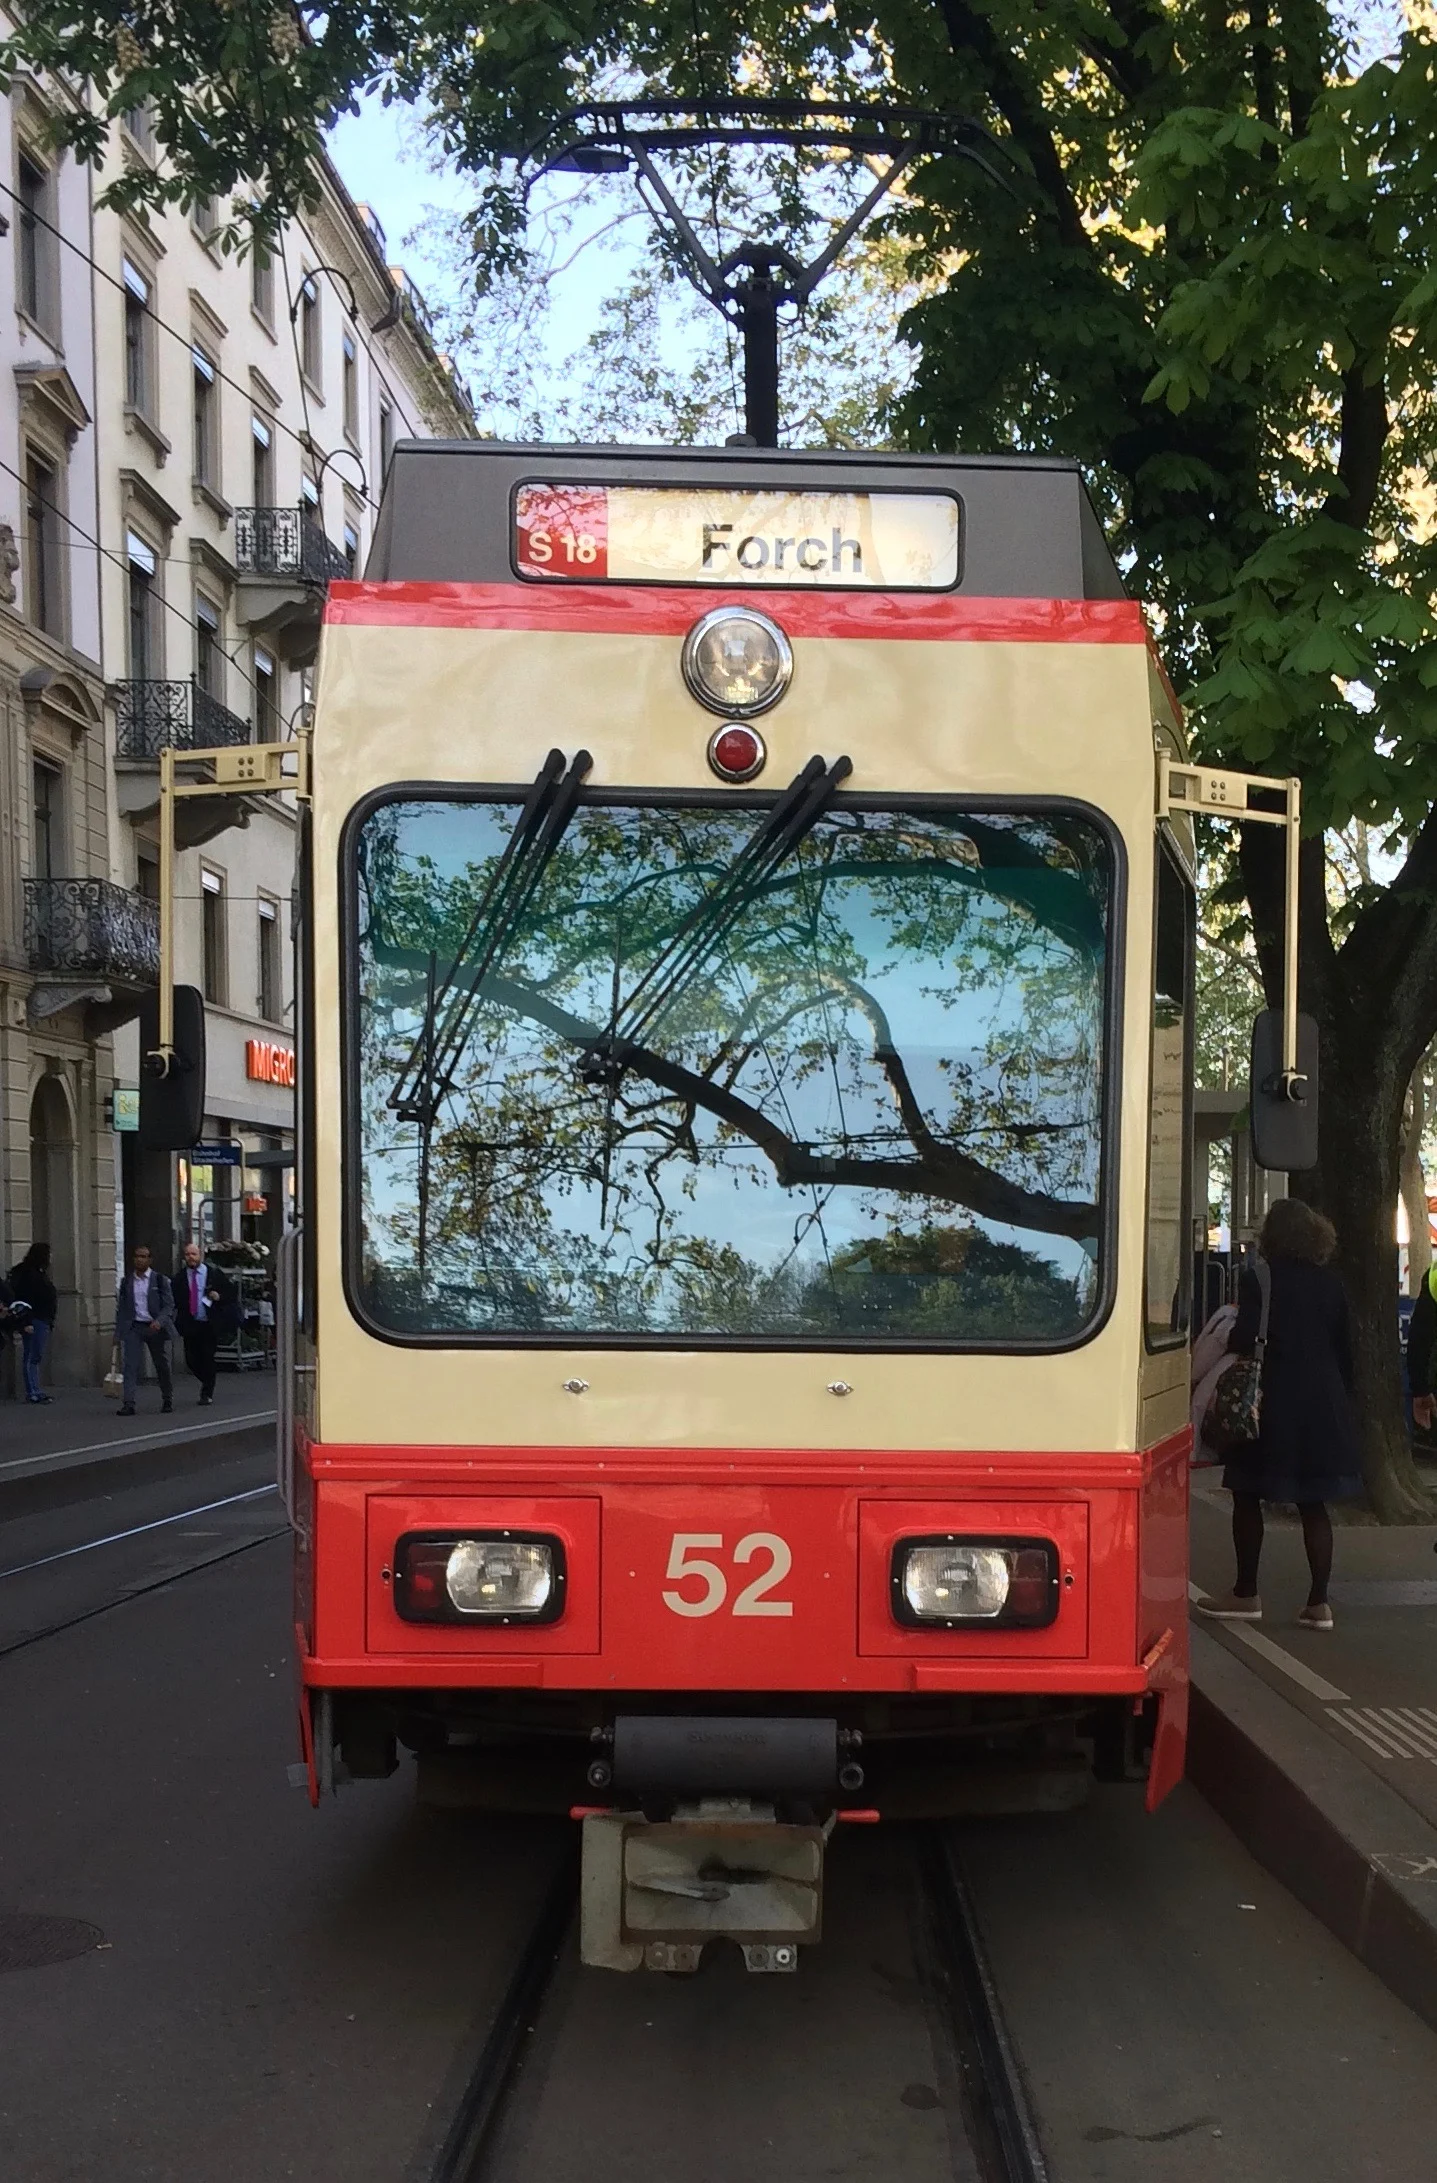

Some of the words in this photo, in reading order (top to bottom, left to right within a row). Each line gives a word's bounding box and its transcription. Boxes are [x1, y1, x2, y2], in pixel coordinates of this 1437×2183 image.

[528, 530, 552, 562] S
[560, 533, 597, 564] 18
[702, 524, 863, 573] Forch
[662, 1532, 793, 1617] 52
